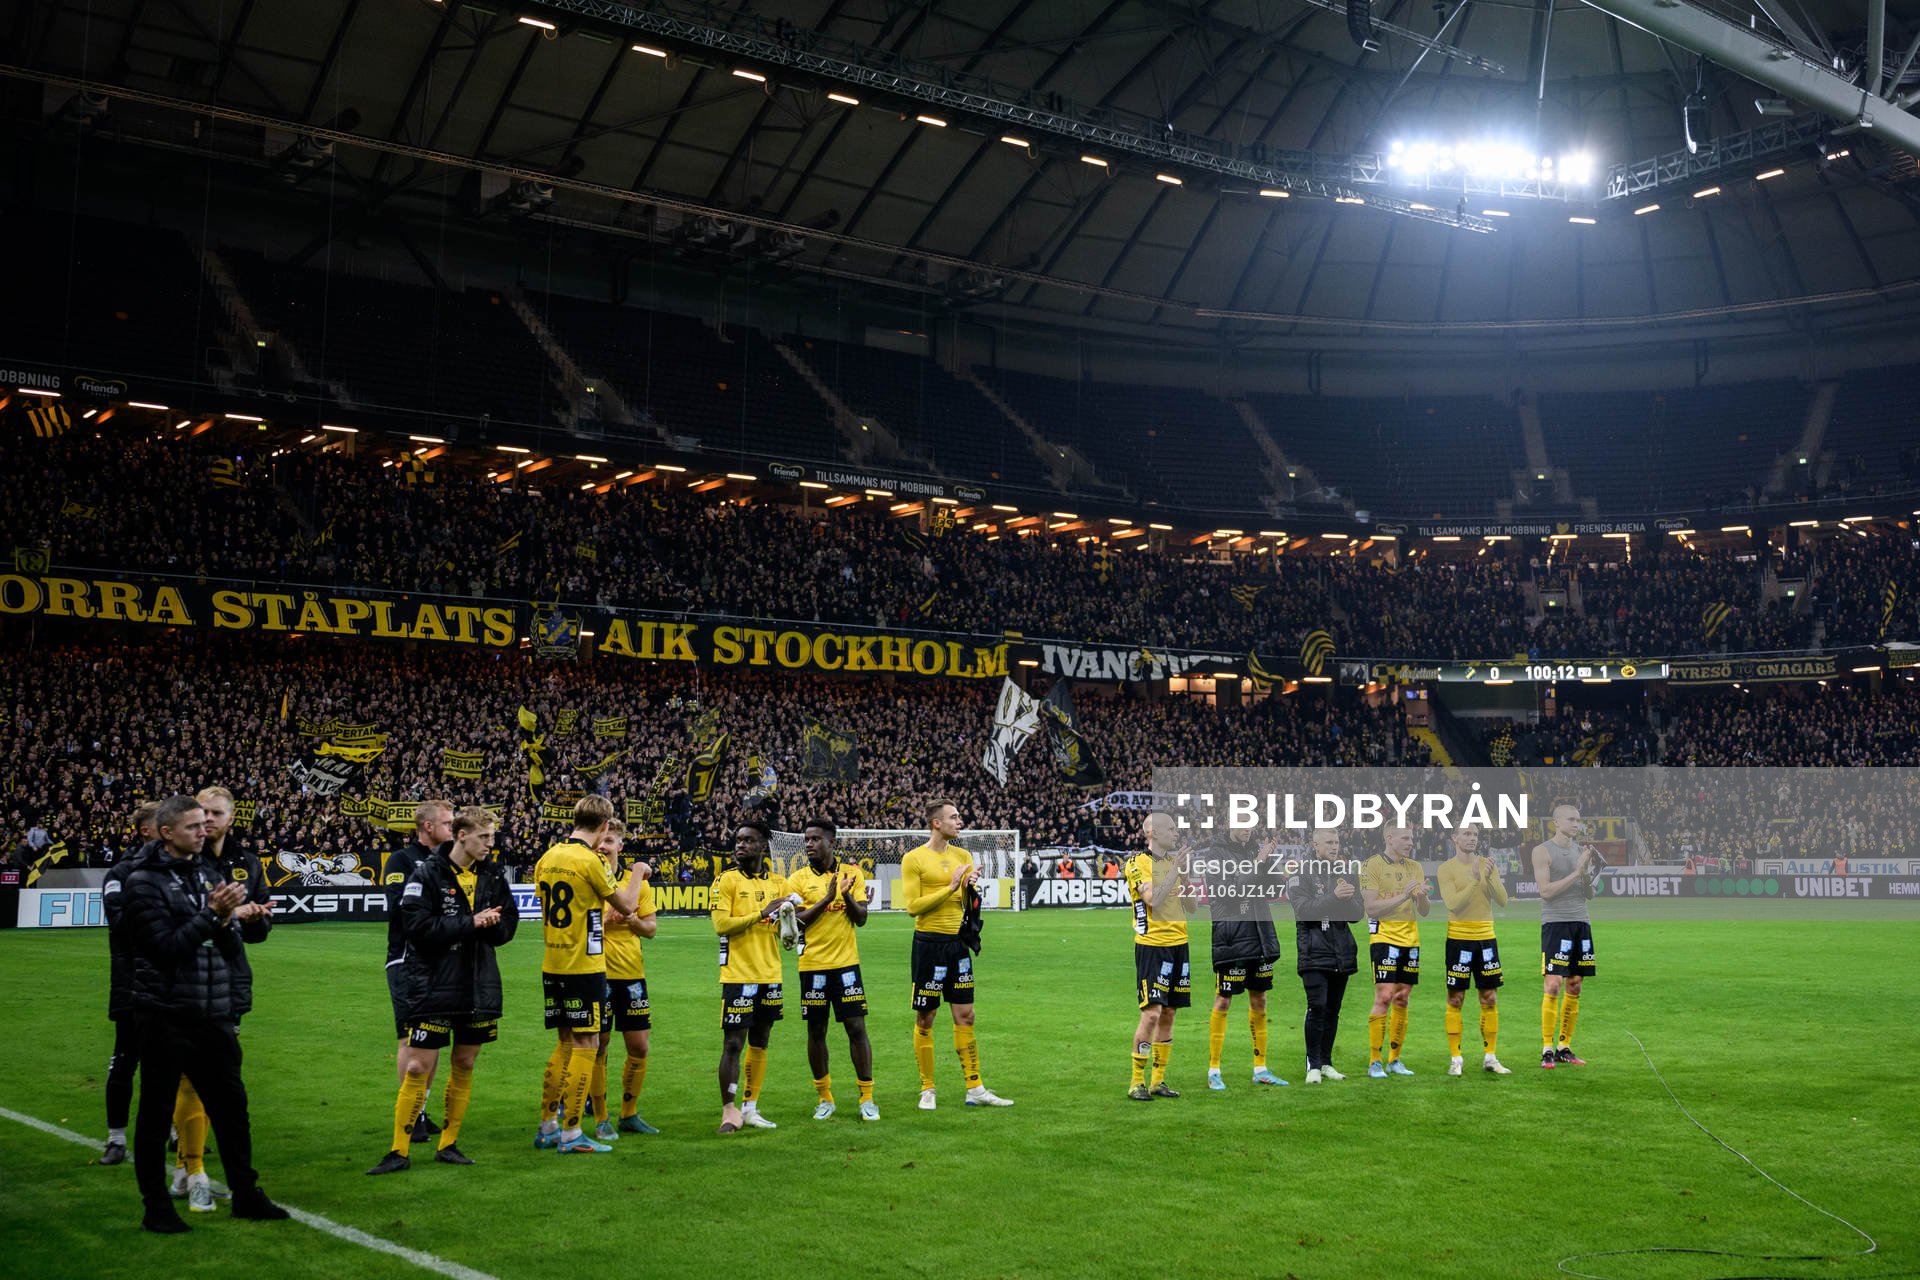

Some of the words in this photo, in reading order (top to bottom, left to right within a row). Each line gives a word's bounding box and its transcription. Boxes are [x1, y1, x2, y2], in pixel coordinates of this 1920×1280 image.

[815, 470, 878, 489] TILLSAMMANS
[880, 478, 899, 490] MOT
[900, 480, 944, 496] MOBBNING
[1418, 526, 1481, 536] TILLSAMMANS
[1484, 525, 1503, 536] MOT
[1504, 524, 1550, 535] MOBBNING
[1574, 523, 1612, 533] FRIENDS
[1614, 522, 1646, 532] ARENA
[211, 589, 516, 649] STÅPLATS
[599, 617, 700, 661] AIK
[712, 625, 1010, 679] STOCKHOLM
[1490, 667, 1500, 680] 0
[1525, 665, 1575, 680] 100:12
[1600, 665, 1608, 679] 1
[1670, 662, 1732, 680] TYRESÖ
[1756, 661, 1837, 677] GNAGARE
[1611, 876, 1682, 896] UNIBET
[1794, 877, 1873, 897] UNIBET
[540, 880, 574, 929] 18
[1378, 970, 1387, 979] 17
[1222, 982, 1232, 991] 12
[916, 996, 927, 1006] 15
[728, 1013, 742, 1024] 26
[415, 1029, 428, 1042] 19
